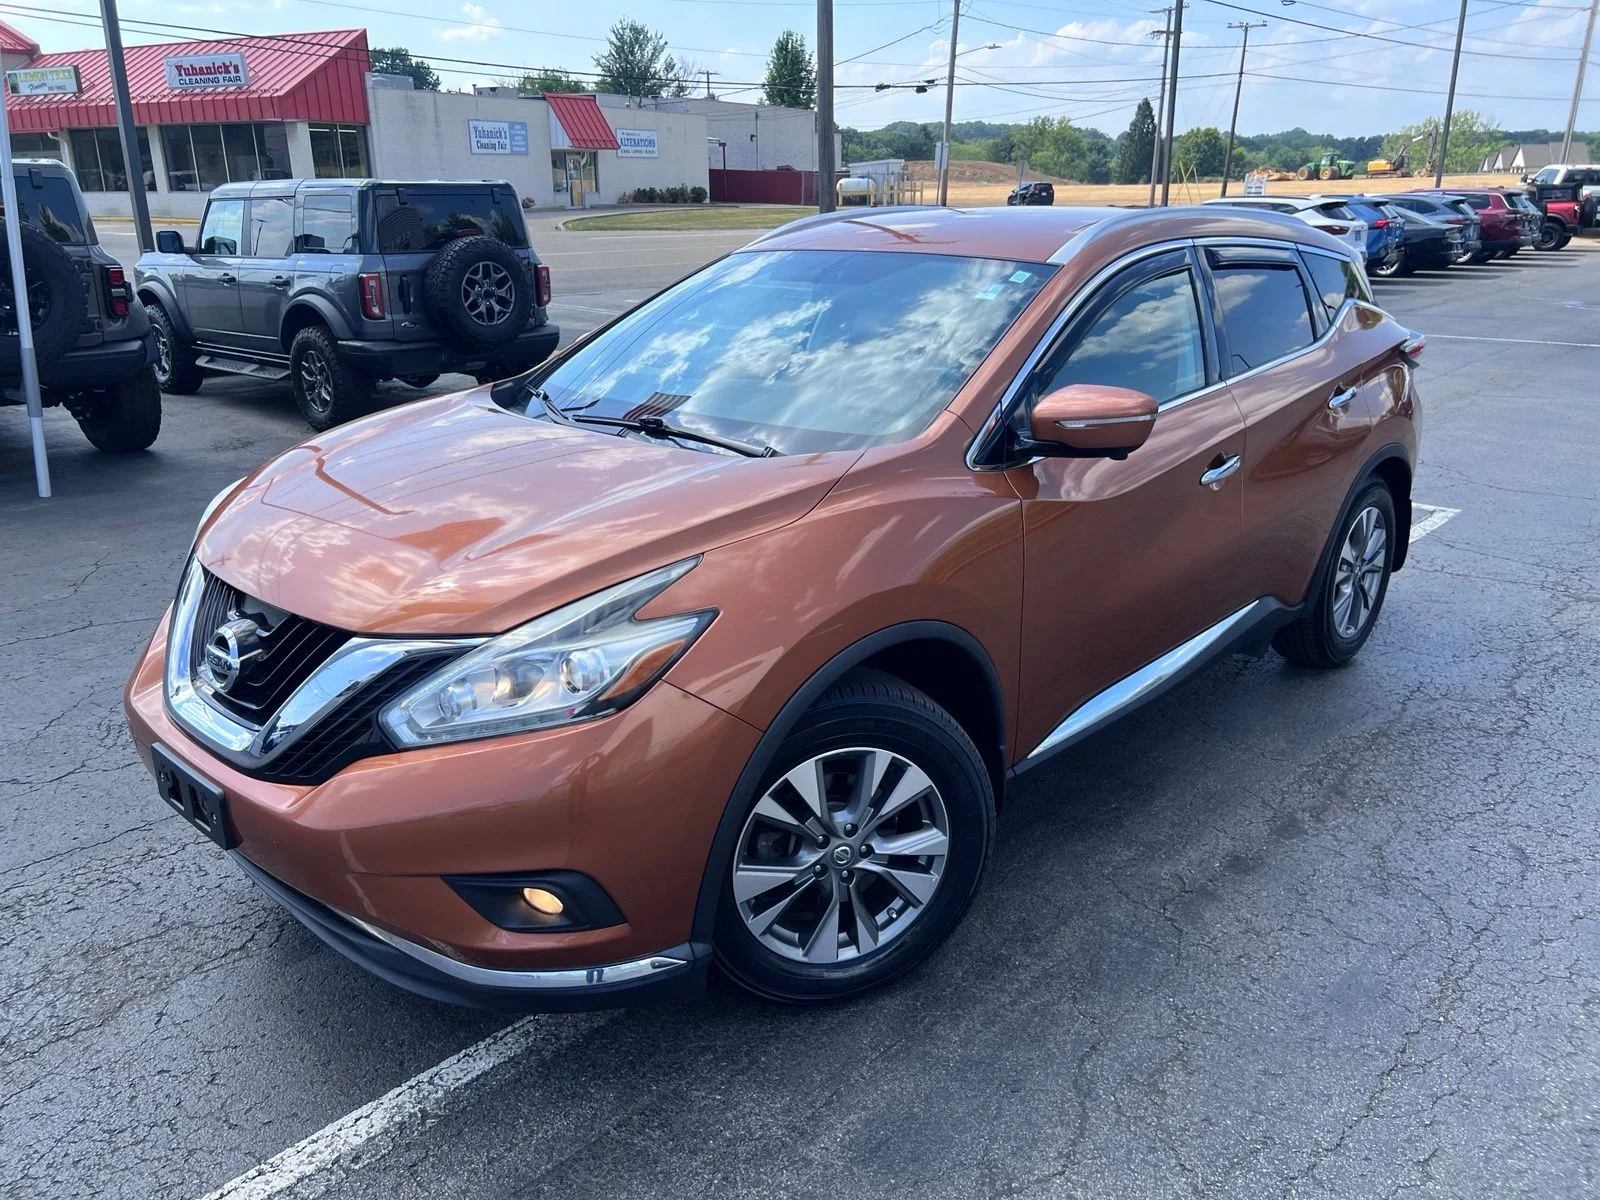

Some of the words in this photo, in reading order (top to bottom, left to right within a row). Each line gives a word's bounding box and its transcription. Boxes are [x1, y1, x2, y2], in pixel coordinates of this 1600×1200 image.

[174, 60, 240, 77] Yuhanick's
[179, 76, 220, 85] CLEANING
[222, 75, 241, 83] FAIR
[473, 126, 507, 139] Yuhanick's
[476, 140, 497, 151] Cleaning
[497, 141, 507, 150] Fair
[620, 137, 656, 148] ALTERATIONS
[206, 653, 233, 671] SSAN
